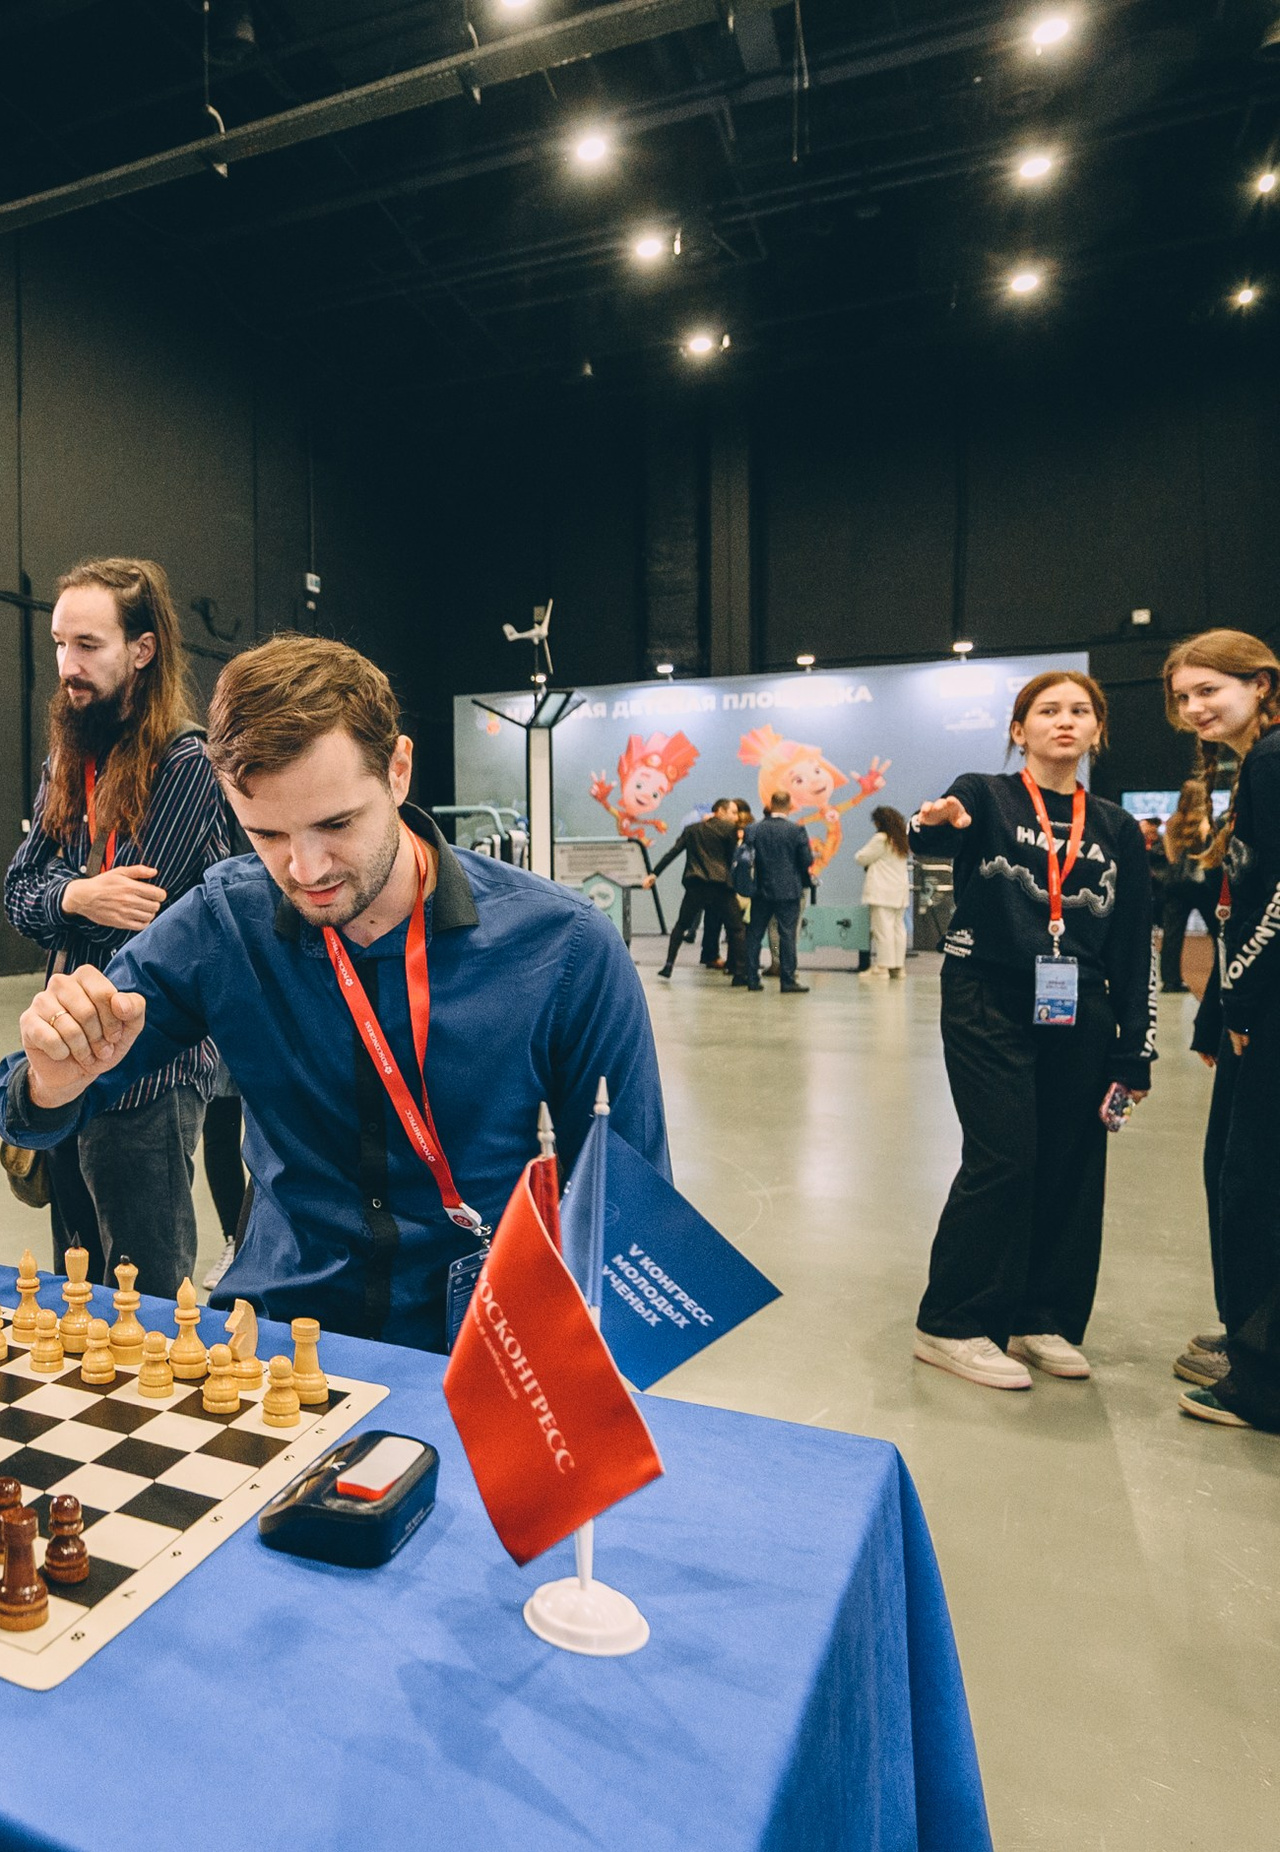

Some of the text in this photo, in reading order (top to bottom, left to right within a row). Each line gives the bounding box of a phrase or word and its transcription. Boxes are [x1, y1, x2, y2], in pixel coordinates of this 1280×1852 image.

[612, 694, 716, 719] ДЕТАЯ
[723, 685, 872, 711] ПЛОКА
[1221, 881, 1280, 989] VOLUNTE
[405, 1109, 431, 1157] РОСКОНГРЕСС
[601, 1265, 662, 1327] УЧЕНЫХ
[611, 1253, 691, 1329] МОЛОДЫХ
[627, 1243, 714, 1327] V КОНГРЕСС
